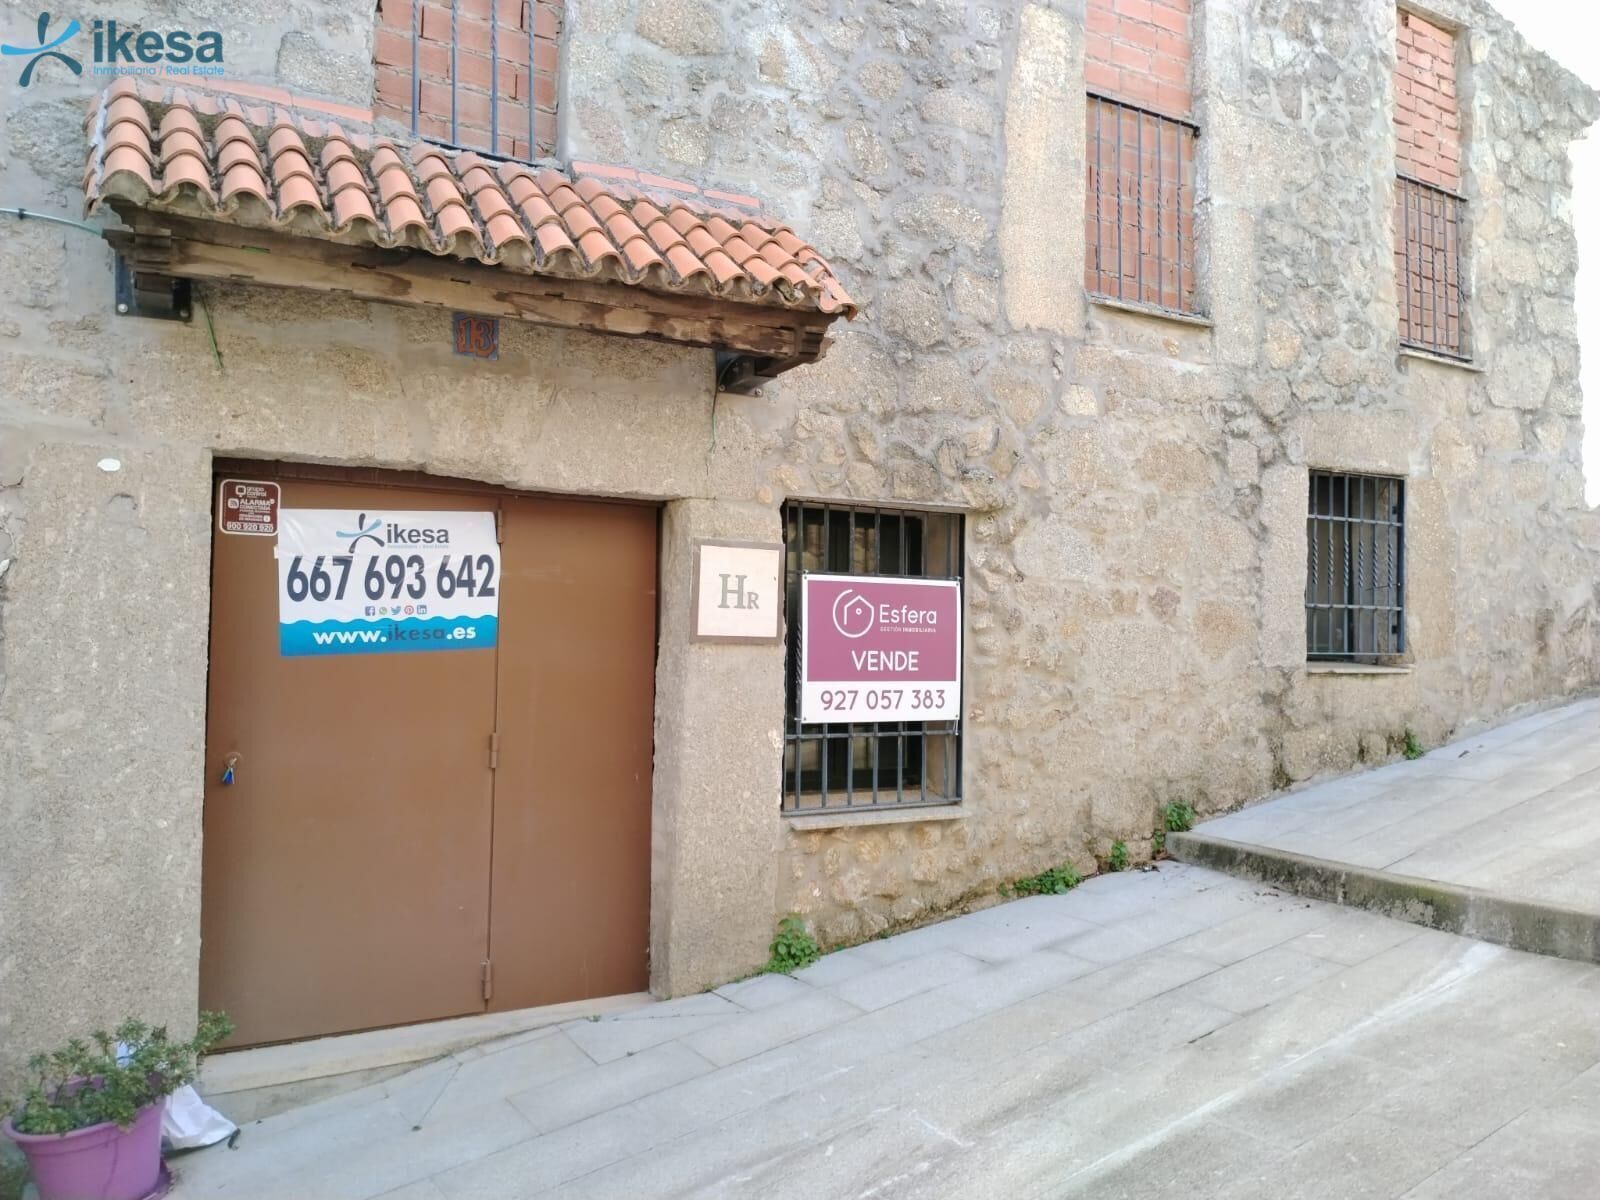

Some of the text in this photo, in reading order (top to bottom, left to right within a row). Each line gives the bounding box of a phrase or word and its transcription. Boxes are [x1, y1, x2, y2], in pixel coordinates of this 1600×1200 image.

[386, 523, 449, 544] ikesa
[286, 553, 495, 602] 667 693 642
[879, 603, 937, 625] Esfera
[312, 624, 477, 645] www.ikesa.es
[851, 650, 920, 672] VENDE
[820, 689, 946, 711] 927 057 383
